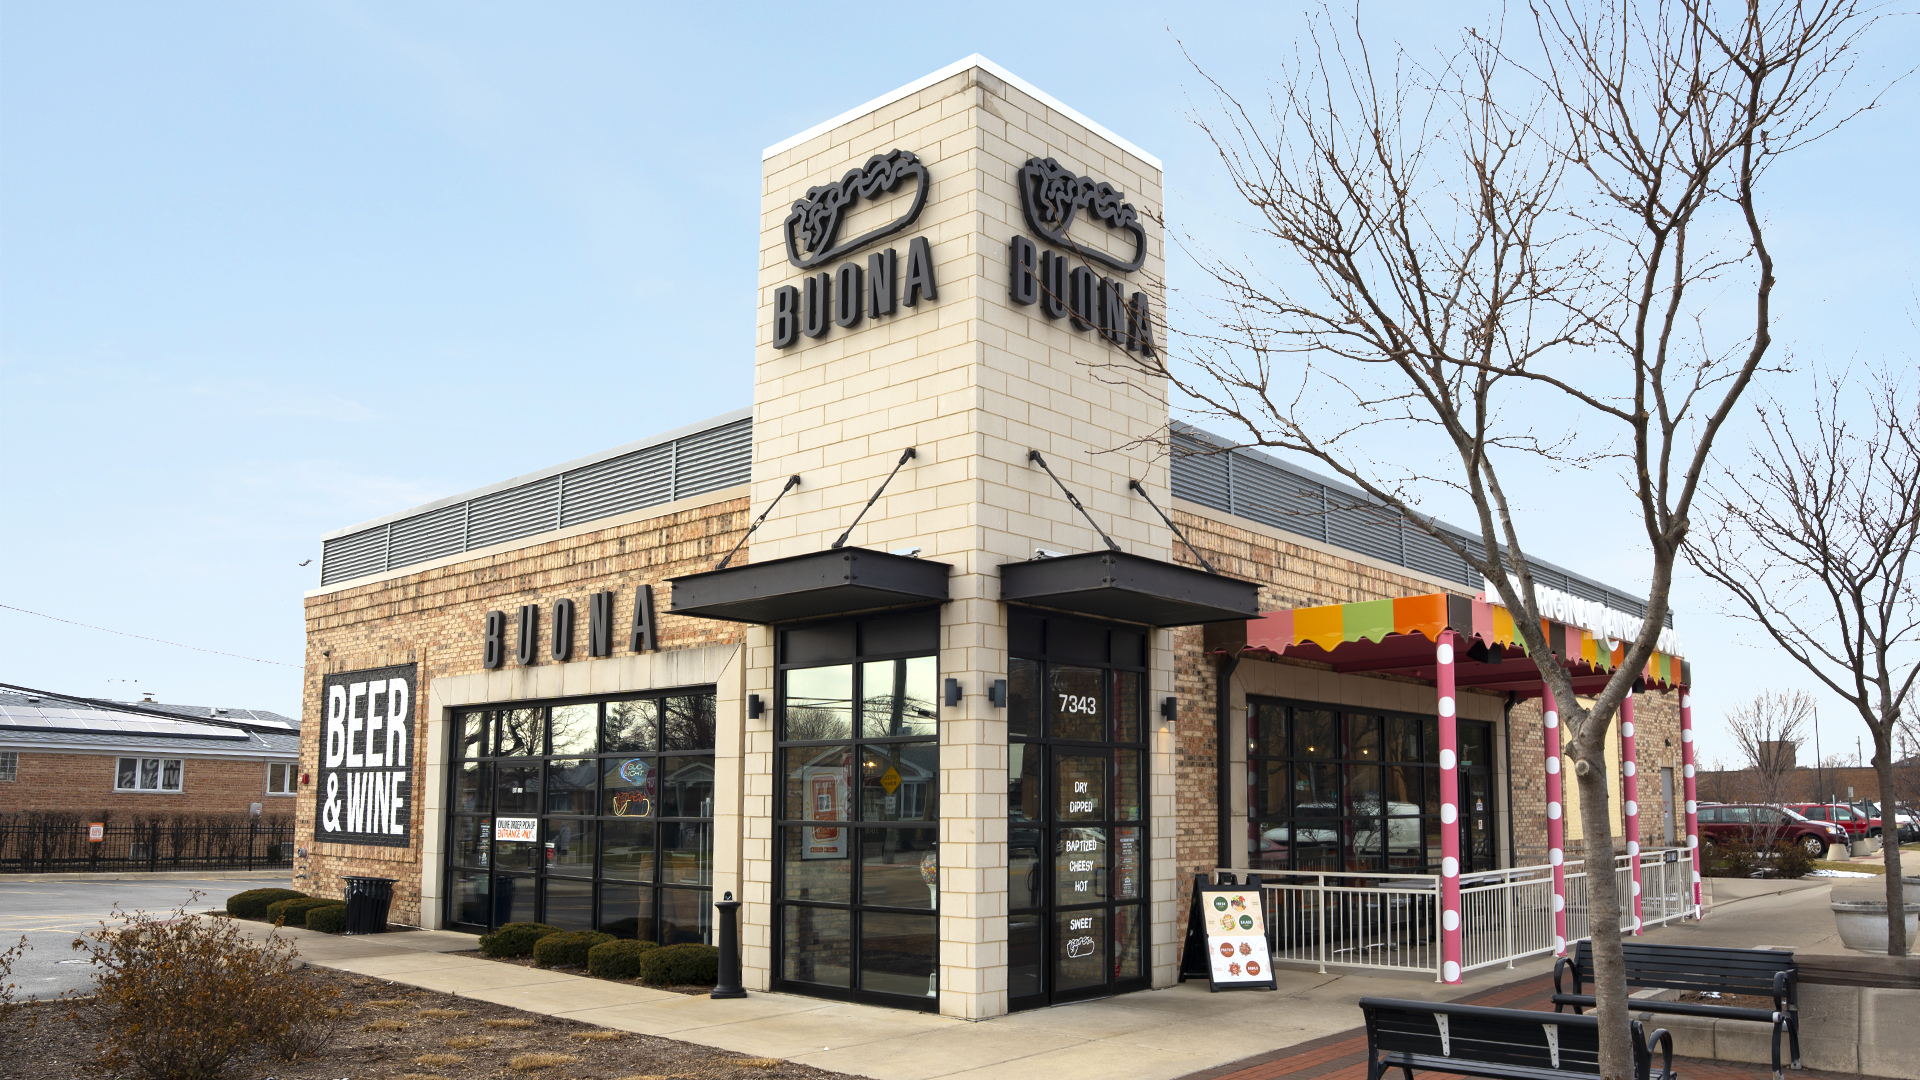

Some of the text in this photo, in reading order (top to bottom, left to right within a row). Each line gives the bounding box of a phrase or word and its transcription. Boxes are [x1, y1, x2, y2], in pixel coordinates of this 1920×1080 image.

[773, 236, 938, 349] BUONA
[1011, 234, 1155, 357] BUONA
[484, 584, 657, 669] BUONA
[1059, 694, 1096, 714] 7343
[326, 678, 408, 768] BEER
[1074, 781, 1088, 794] DRY
[323, 772, 405, 834] & WINE
[498, 828, 532, 839] ENTRANCE ONLY
[1069, 861, 1094, 872] CHEESY
[1074, 881, 1088, 892] HOT
[1070, 918, 1092, 930] SWEET
